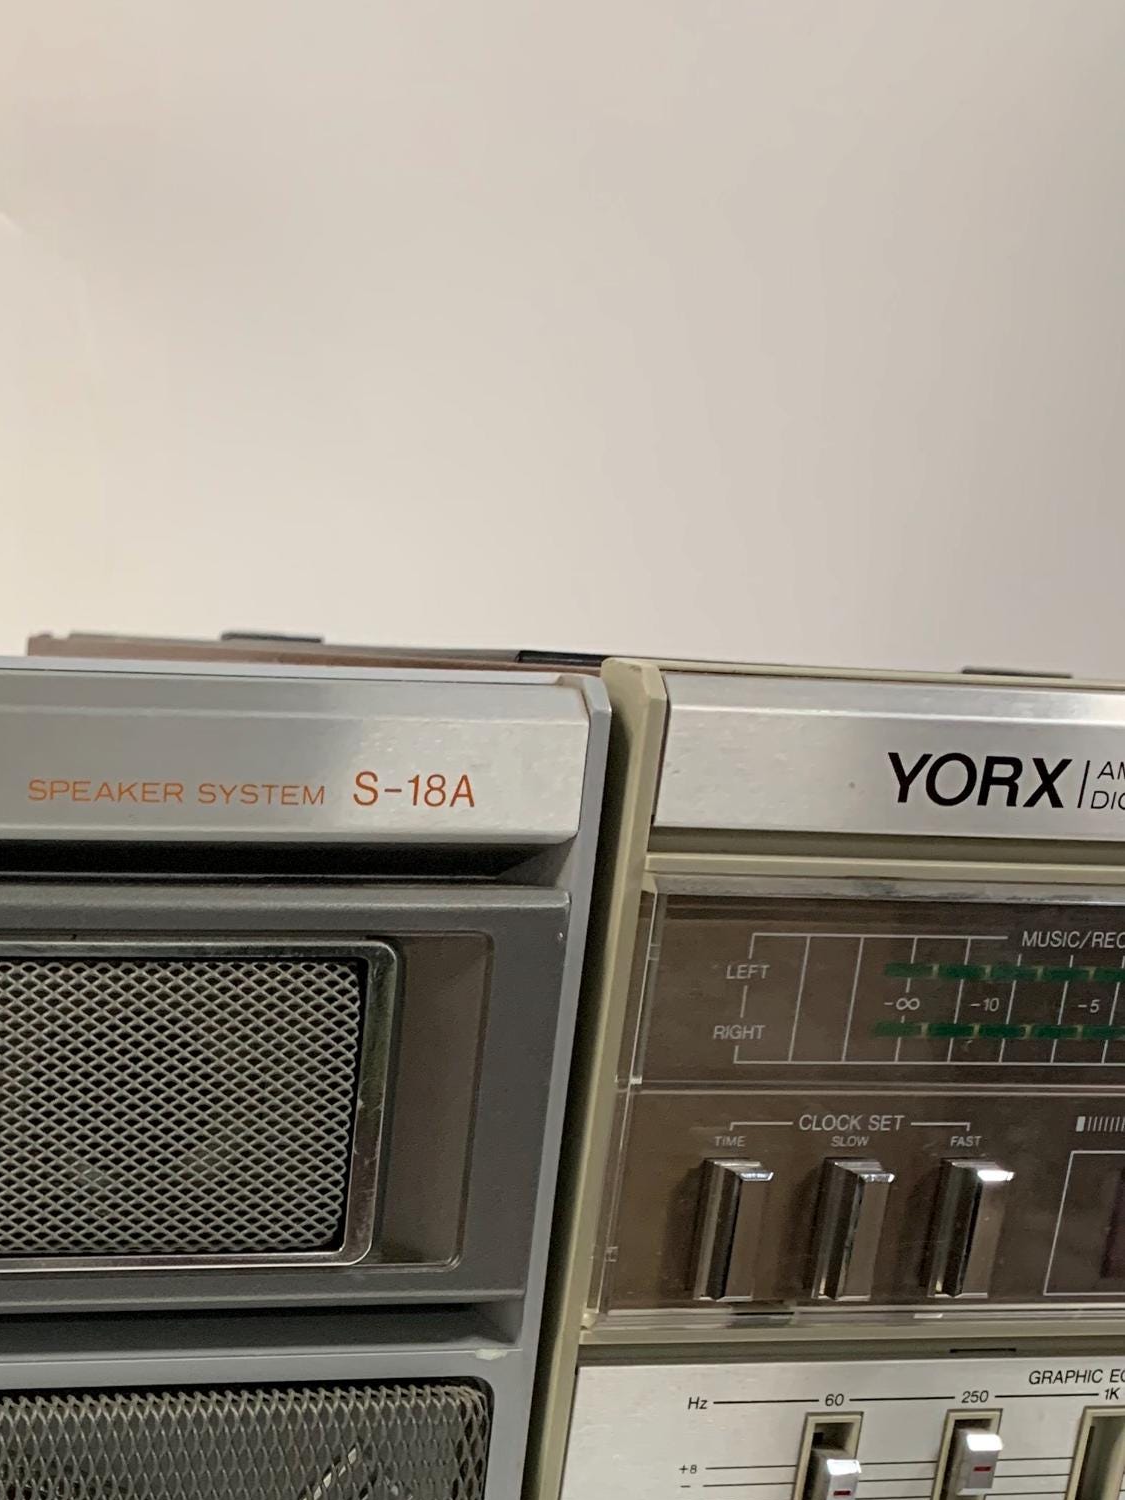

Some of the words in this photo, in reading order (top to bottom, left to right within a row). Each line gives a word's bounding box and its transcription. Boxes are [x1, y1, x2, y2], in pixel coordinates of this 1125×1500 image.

[887, 751, 1073, 809] YORX
[27, 779, 184, 803] SPEAKER
[197, 782, 325, 806] SYSTEM
[352, 770, 475, 808] S-18A
[725, 964, 770, 980] LEFT
[712, 1024, 766, 1040] RIGHT
[798, 1113, 863, 1132] CLOCK
[867, 1114, 906, 1131] SET
[714, 1135, 746, 1148] TIME
[830, 1135, 870, 1148] SLOW
[950, 1135, 982, 1147] FAST
[1028, 1368, 1104, 1385] GRAPHIC
[687, 1396, 708, 1410] Hz
[824, 1393, 845, 1407] 60
[961, 1389, 989, 1404] 250
[1104, 1387, 1121, 1401] 1K
